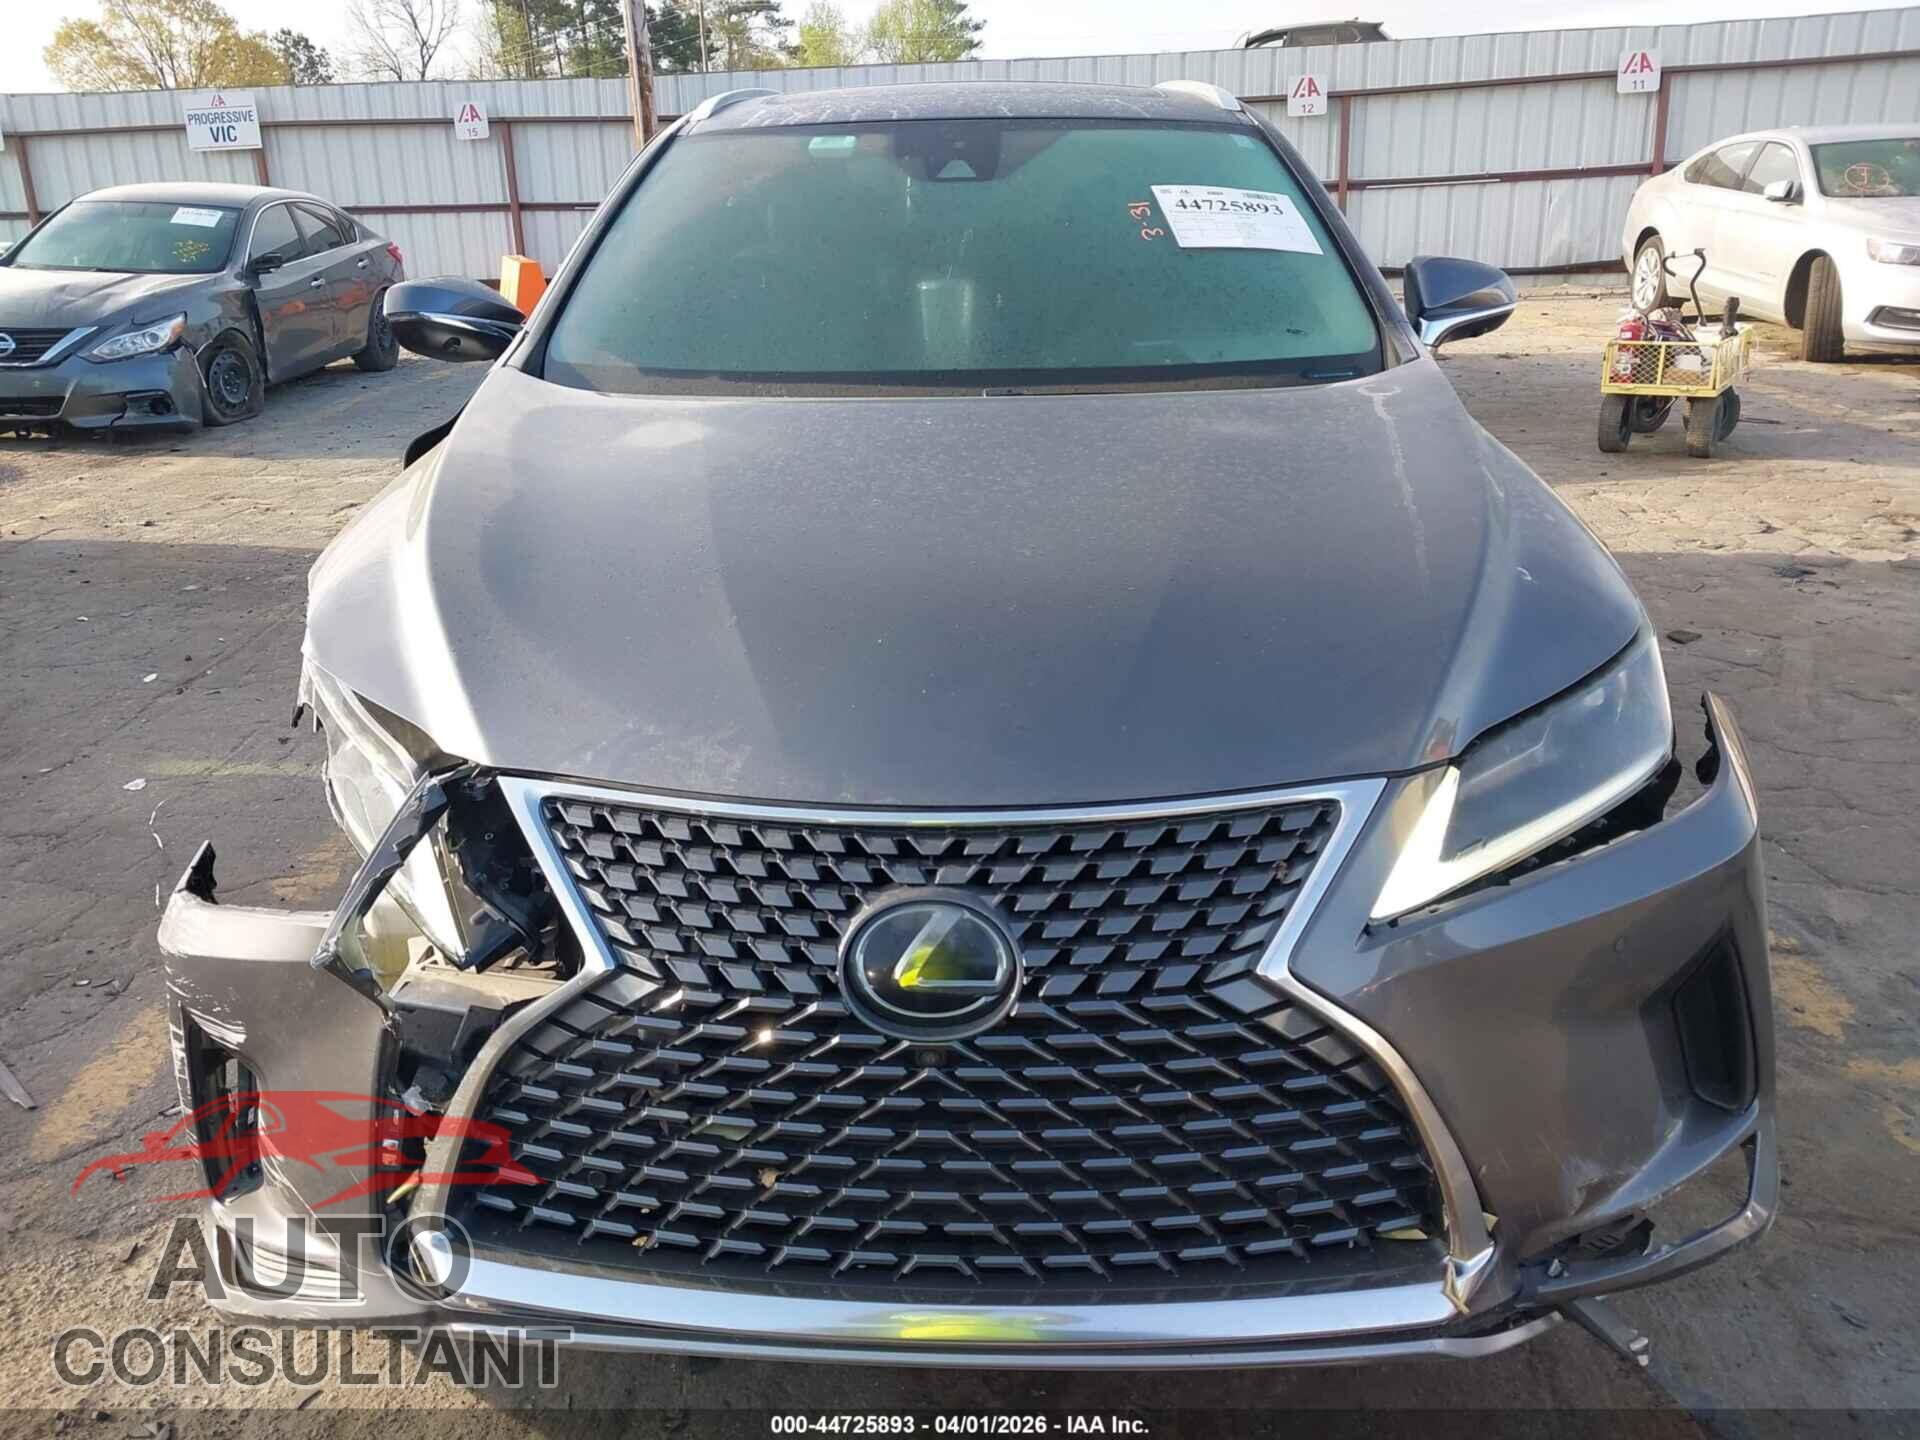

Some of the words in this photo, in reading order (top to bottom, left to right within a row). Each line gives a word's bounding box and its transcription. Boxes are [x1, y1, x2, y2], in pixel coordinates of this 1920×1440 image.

[1631, 79, 1646, 90] 11
[1301, 103, 1315, 115] 12
[187, 110, 255, 126] PROGRESSIVE
[209, 125, 238, 143] VIC
[1175, 198, 1284, 216] 44725893
